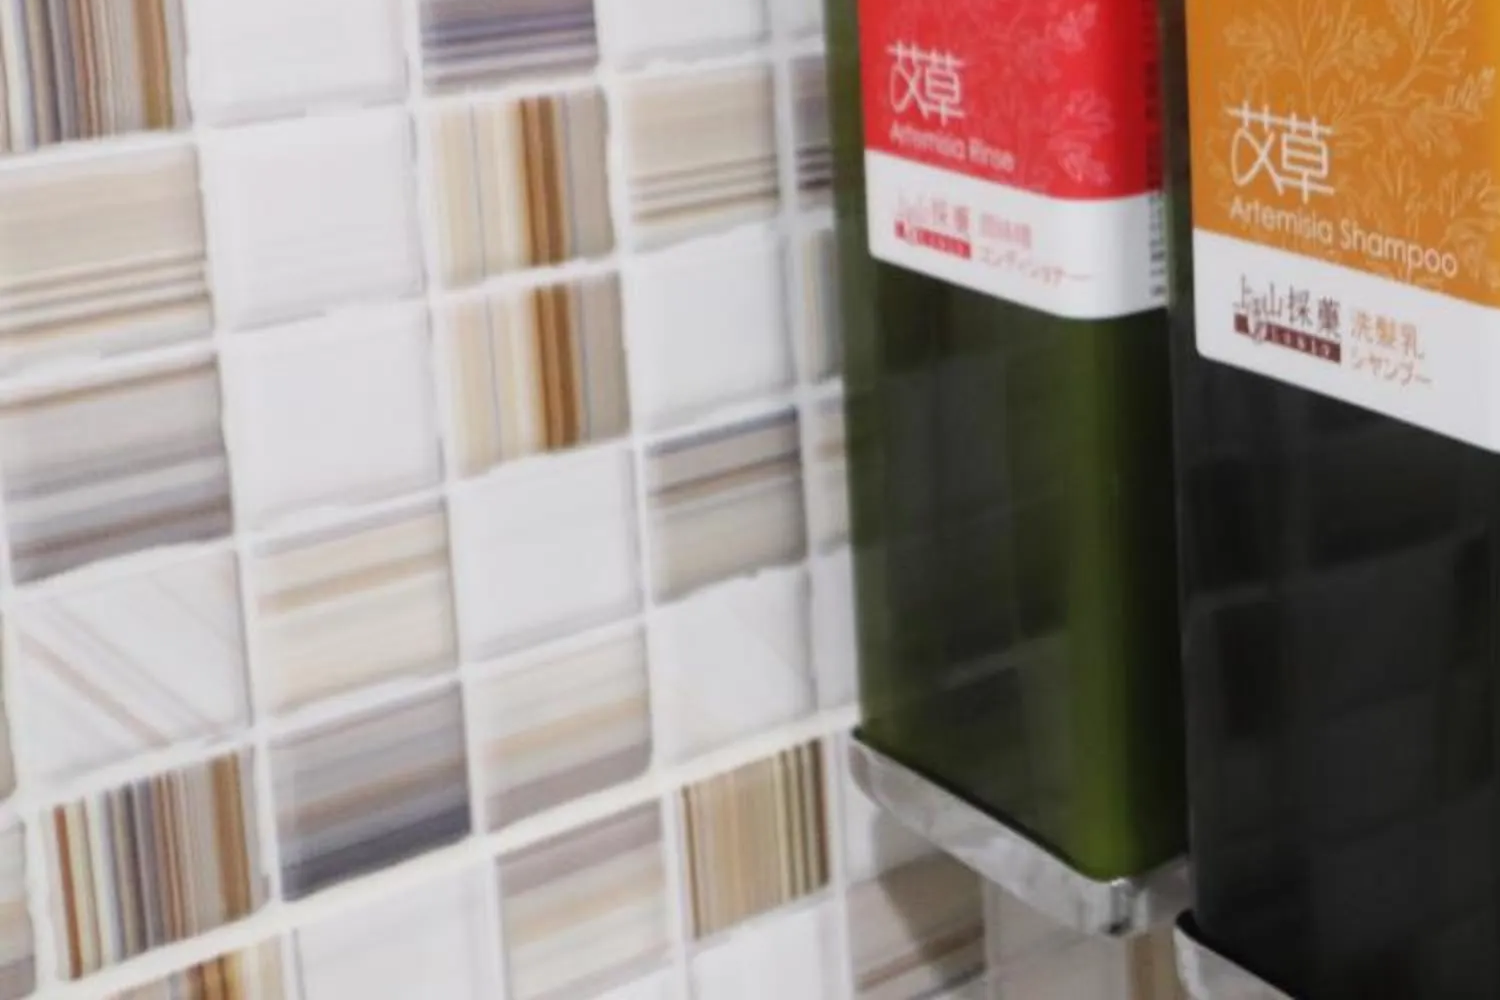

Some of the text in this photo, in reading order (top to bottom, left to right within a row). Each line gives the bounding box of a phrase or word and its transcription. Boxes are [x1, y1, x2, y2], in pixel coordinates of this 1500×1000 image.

[887, 40, 965, 126] 艾草
[1227, 101, 1335, 204] 艾草
[1230, 196, 1459, 281] Artemisia Shampoo
